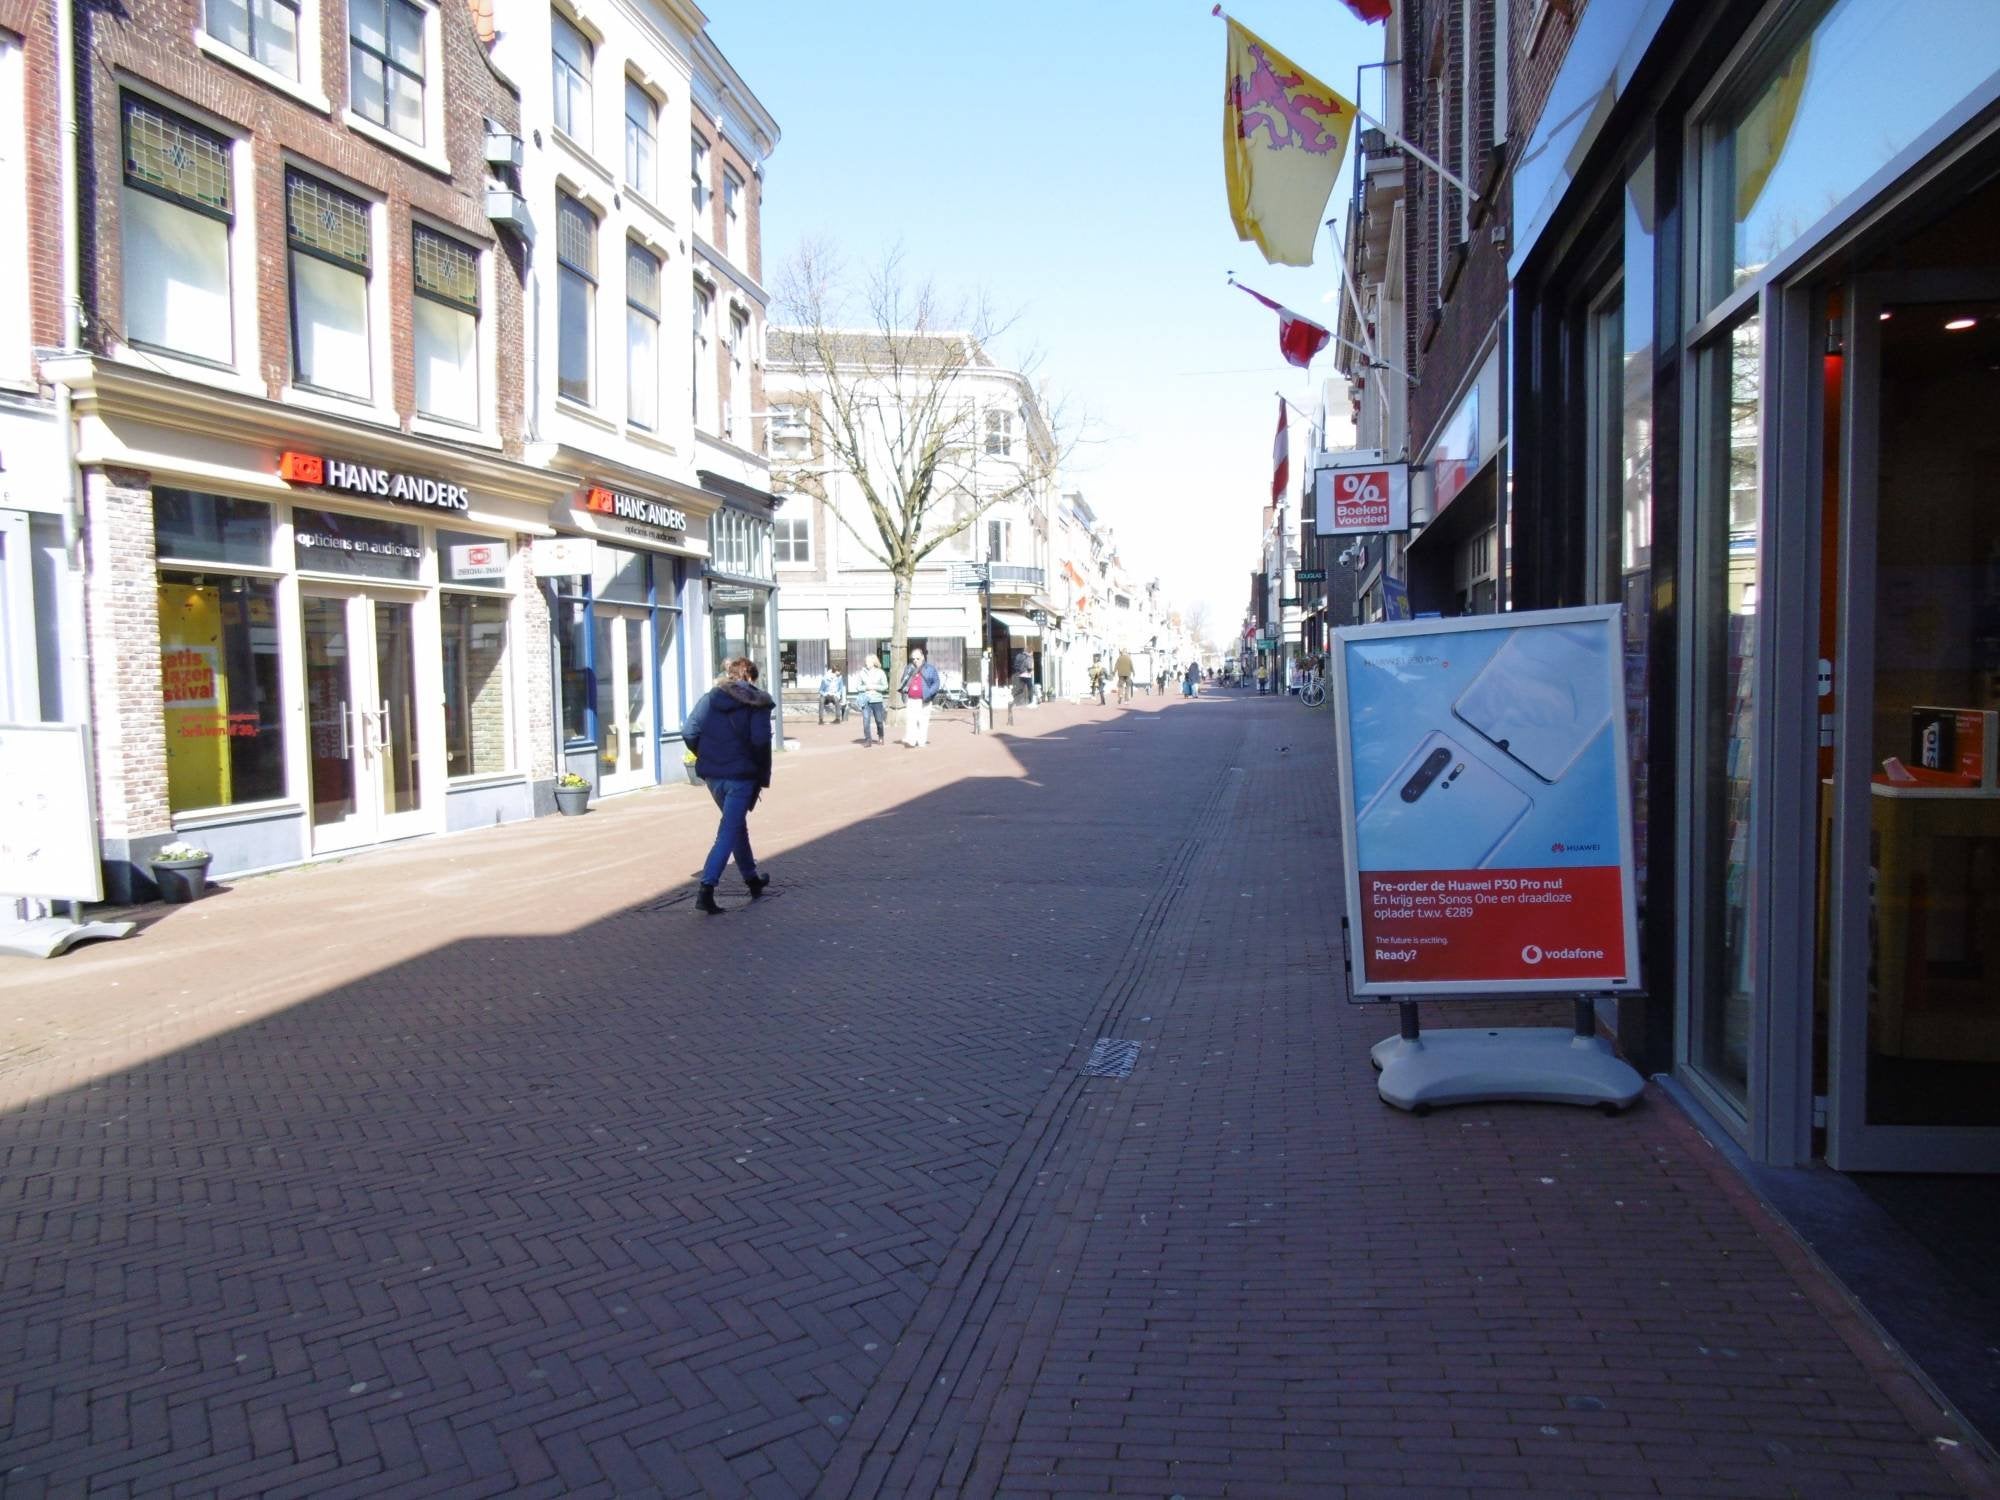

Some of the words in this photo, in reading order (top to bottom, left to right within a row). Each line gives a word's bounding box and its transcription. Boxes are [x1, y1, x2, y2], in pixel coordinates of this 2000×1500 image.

[328, 459, 389, 496] HANS
[393, 474, 469, 510] ANDERS
[615, 494, 646, 521] HANS
[648, 504, 687, 531] ANDERS
[1337, 505, 1387, 516] Boeken
[1338, 514, 1388, 525] Voordeel
[296, 532, 353, 551] opticiens
[354, 540, 370, 552] en
[371, 541, 421, 559] audiciens
[1566, 843, 1601, 852] HUAWEI
[1373, 880, 1428, 892] Pre-order
[1431, 880, 1446, 891] de
[1448, 880, 1491, 891] Huawei
[1494, 879, 1518, 890] P30
[1520, 879, 1541, 890] Pro
[1543, 878, 1563, 889] nu!
[1373, 894, 1388, 905] En
[1390, 893, 1413, 907] krijg
[1415, 896, 1436, 905] een
[1438, 893, 1473, 905] Sonos
[1475, 893, 1498, 904] One
[1500, 895, 1516, 904] en
[1518, 892, 1573, 904] draadloze
[1374, 907, 1415, 920] oplader
[1417, 908, 1443, 918] t.w.v.
[1445, 907, 1473, 918] €289
[1375, 936, 1390, 944] The
[1390, 936, 1412, 945] future
[1412, 936, 1420, 945] is
[1420, 936, 1449, 946] exciting.
[1375, 949, 1417, 963] Ready?
[1545, 948, 1604, 960] vodafone
